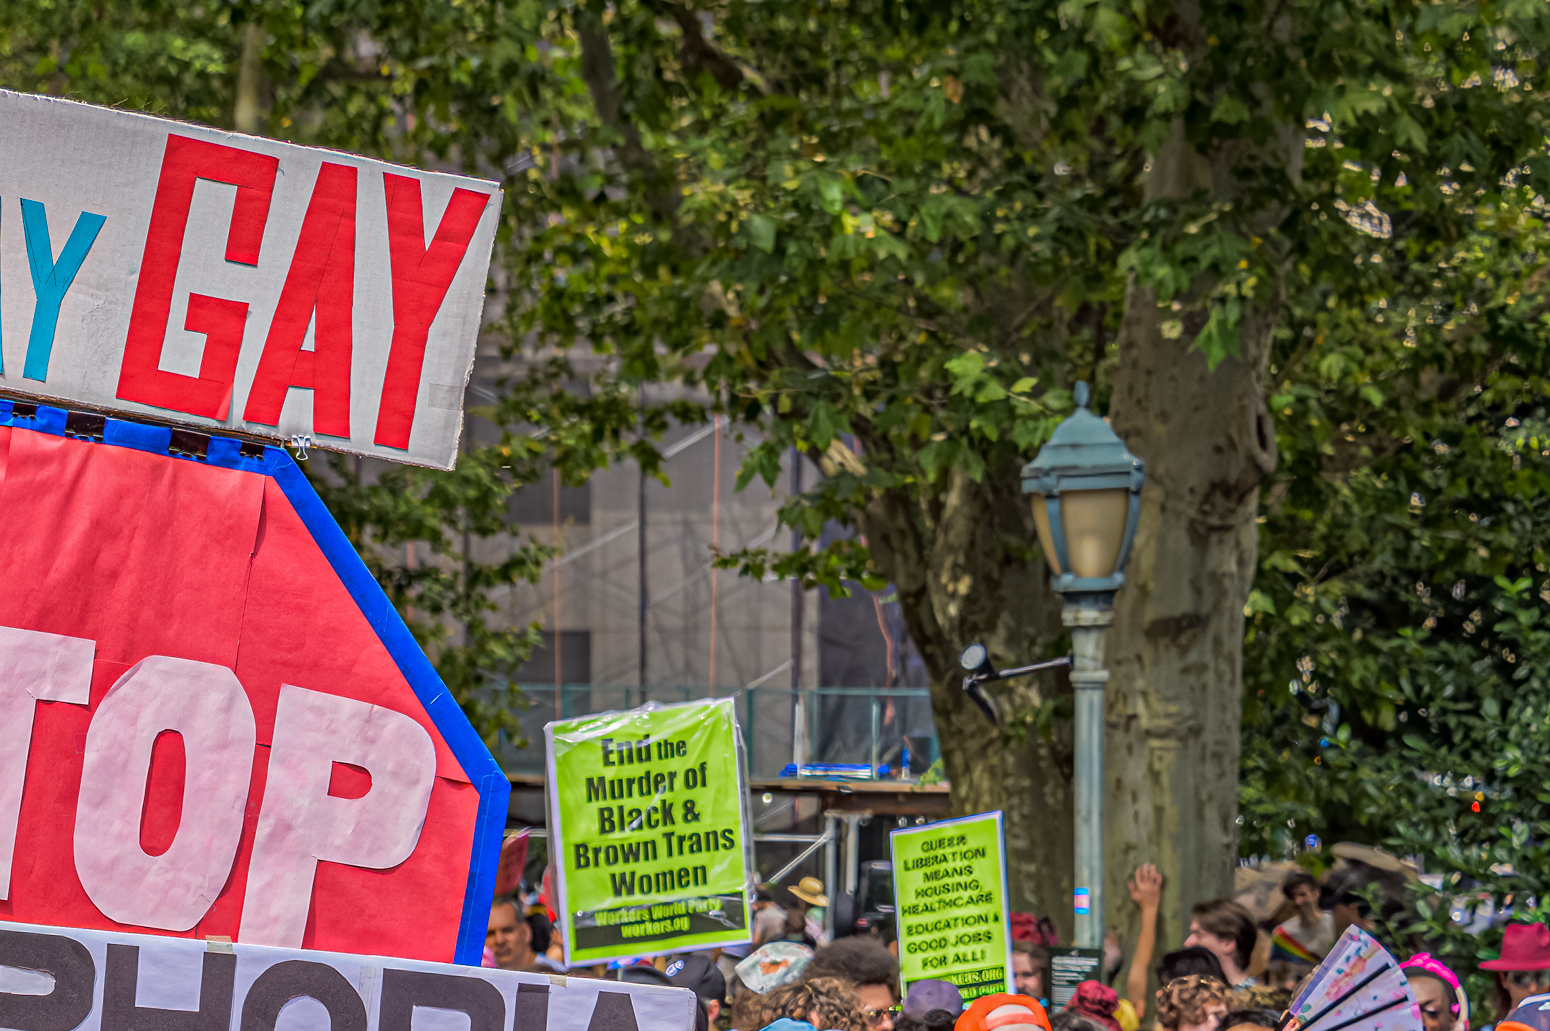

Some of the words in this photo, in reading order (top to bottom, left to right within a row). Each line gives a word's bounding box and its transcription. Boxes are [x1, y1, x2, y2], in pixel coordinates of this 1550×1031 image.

[116, 133, 491, 452] GAY
[601, 734, 652, 768] End
[656, 738, 687, 761] the
[585, 770, 677, 803] Murder
[683, 761, 707, 790] of
[598, 799, 675, 835] Black
[682, 799, 700, 824] &
[574, 838, 657, 870] Brown
[662, 828, 736, 859] Trans
[921, 834, 967, 853] QUEER
[903, 847, 986, 871] LIBERATION
[610, 864, 708, 897] Women
[923, 865, 974, 883] MEANS
[595, 907, 650, 927] Workers
[651, 900, 687, 920] World
[901, 891, 994, 917] HEALTHCARE
[906, 913, 989, 937] EDUCATION
[906, 937, 948, 955] GOOD
[950, 930, 993, 947] JOBS
[922, 955, 948, 971] FOR
[952, 950, 987, 965] ALL!
